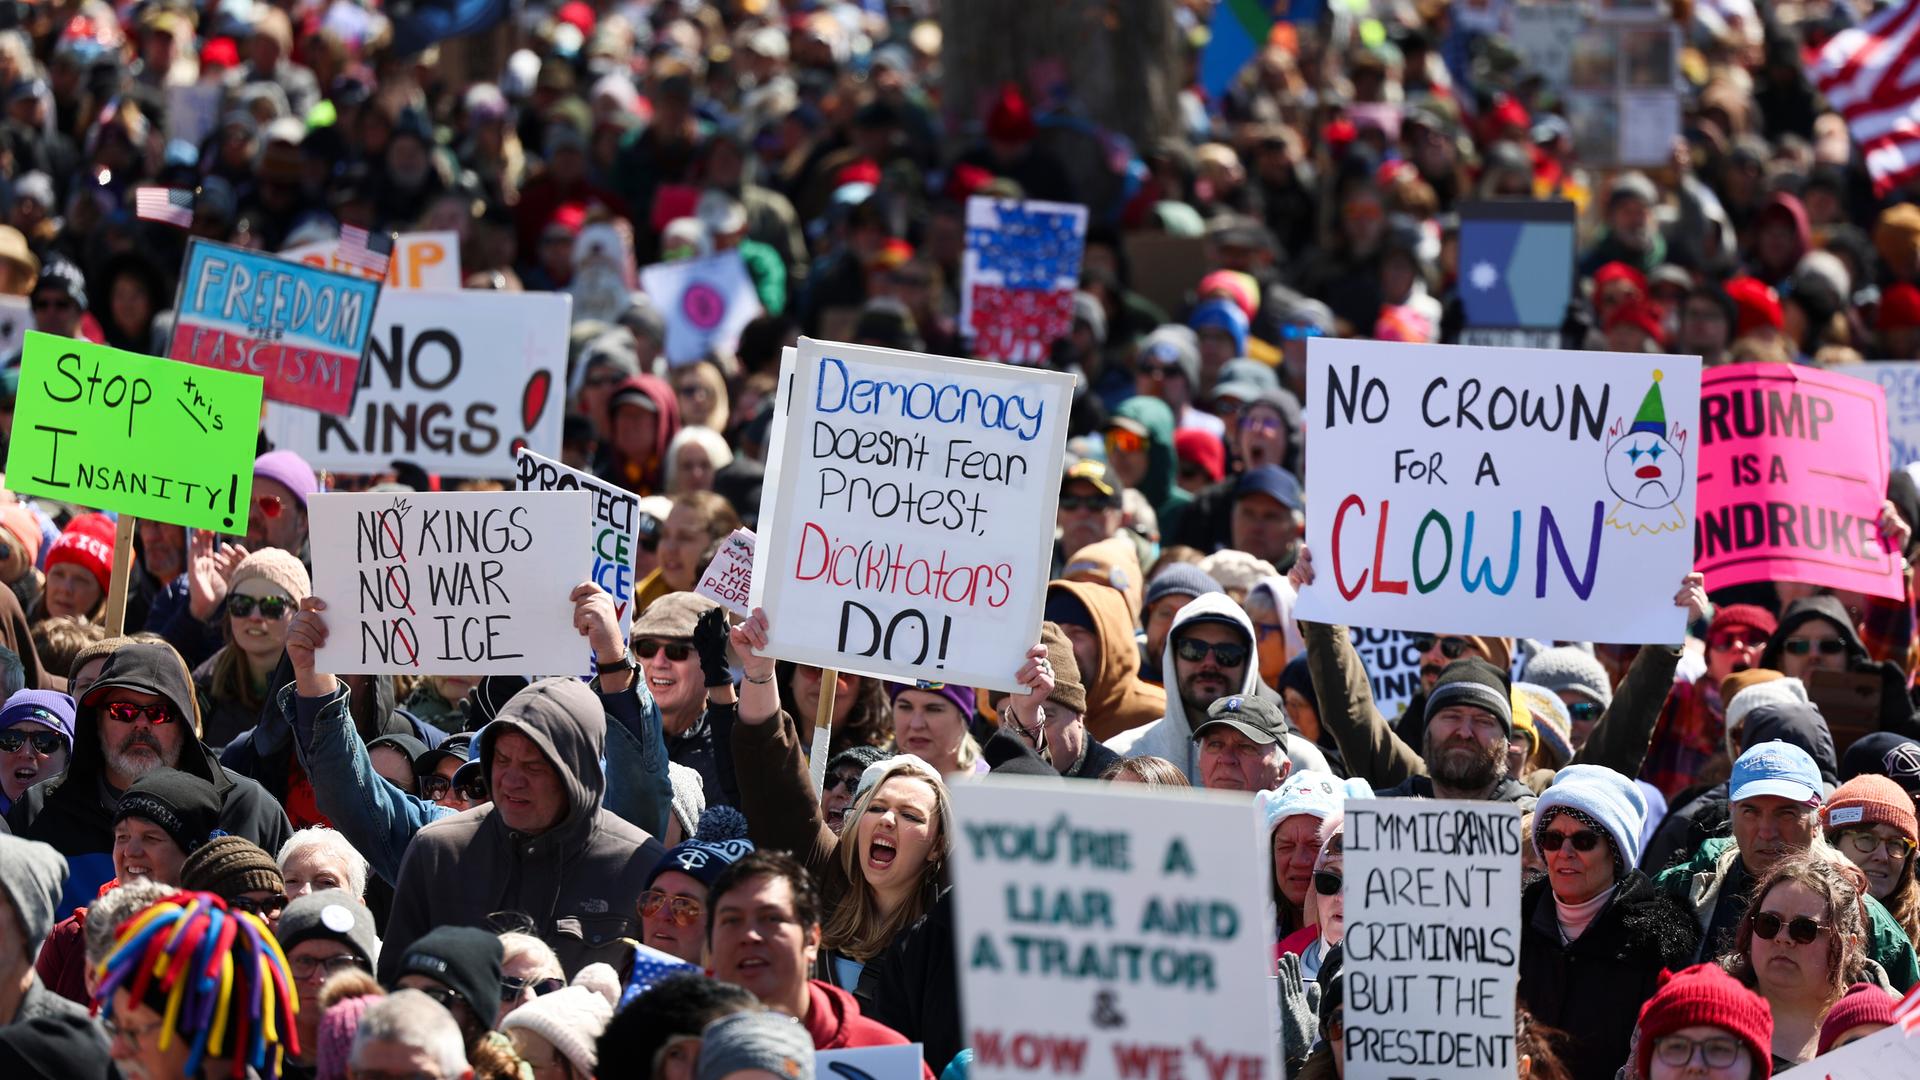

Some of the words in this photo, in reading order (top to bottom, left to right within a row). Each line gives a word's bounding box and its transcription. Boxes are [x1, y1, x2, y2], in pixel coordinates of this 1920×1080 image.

[194, 255, 364, 350] FREEDOM
[191, 328, 342, 394] FASCISM
[361, 324, 461, 392] NO
[44, 353, 152, 438] Stop
[183, 376, 224, 431] this
[816, 357, 1044, 441] Democracy
[1326, 364, 1390, 429] NO
[1422, 376, 1610, 441] CROWN
[1701, 389, 1834, 446] RUMP
[813, 421, 929, 471] Doesn't
[946, 440, 1027, 486] Fear
[1395, 449, 1448, 485] FOR
[1475, 452, 1500, 487] A
[1731, 453, 1762, 487] IS
[1768, 455, 1788, 484] A
[818, 467, 987, 536] Protest,
[357, 508, 405, 563] NO
[418, 506, 533, 556] KINGS
[723, 547, 753, 567] KIN
[1332, 494, 1604, 601] CLOWN
[359, 565, 413, 614] NO
[428, 560, 510, 606] WAR
[703, 577, 749, 608] PEOPL
[719, 571, 751, 594] THE
[361, 617, 419, 667] NO
[433, 615, 524, 663] ICE
[837, 600, 952, 669] DO!
[964, 812, 1133, 872] YOU'RE
[1163, 835, 1195, 876] A
[1344, 810, 1520, 856] IMMIGRANTS
[1006, 883, 1113, 927] LIAR
[1142, 898, 1239, 940] AND
[1365, 865, 1501, 909] AREN'T
[971, 932, 1003, 971] A
[1008, 934, 1216, 993] TRAITOR
[1346, 921, 1516, 967] CRIMINALS
[1092, 989, 1126, 1030] &
[1350, 971, 1417, 1016] BUT
[1427, 975, 1502, 1019] THE
[973, 1030, 1087, 1076] NOW
[1346, 1025, 1514, 1069] PRESIDENT
